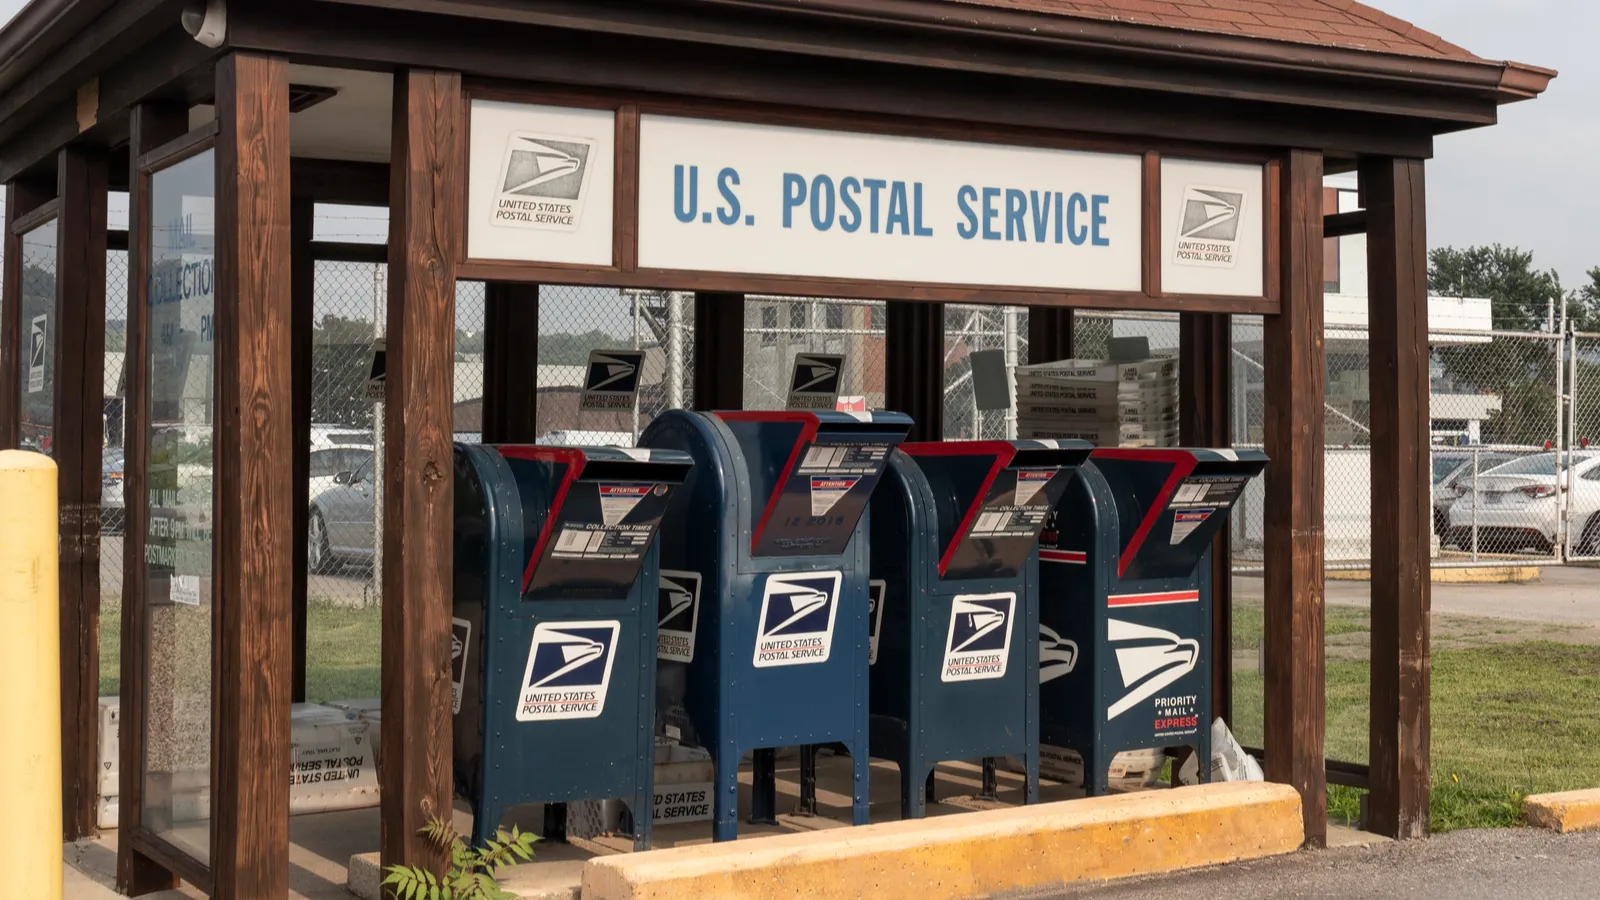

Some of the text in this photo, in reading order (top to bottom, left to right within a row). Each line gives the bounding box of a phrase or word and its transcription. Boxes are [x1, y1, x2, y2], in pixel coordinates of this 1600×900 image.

[497, 199, 572, 214] UNITED STATES
[673, 163, 1110, 247] U.S. POSTAL SERVICE
[495, 210, 574, 225] POSTAL SERVICE
[1178, 241, 1231, 254] UNITED STATES
[1176, 250, 1232, 264] POSTAL SERVICE
[1045, 391, 1059, 399] STATES
[149, 489, 160, 508] ALL
[149, 516, 169, 537] AFTER
[170, 518, 176, 539] 9
[585, 523, 630, 531] COLLECTION
[671, 635, 689, 646] STATES
[760, 637, 823, 651] UNITED STATES
[669, 646, 691, 657] SERVICE
[759, 647, 825, 662] POSTAL SERVICE
[948, 654, 1000, 666] UNITED STATES
[946, 664, 1002, 676] POSTAL SERVICE
[525, 691, 596, 703] UNITED STATES
[1154, 695, 1197, 708] PRIORITY
[522, 702, 598, 714] POSTAL SERVICE
[1164, 707, 1187, 717] MAIL
[1154, 716, 1197, 729] EXPRESS
[324, 756, 364, 767] POSTAL
[1063, 755, 1082, 765] SERVICE
[665, 791, 706, 805] STATES
[663, 804, 709, 819] SERVICE
